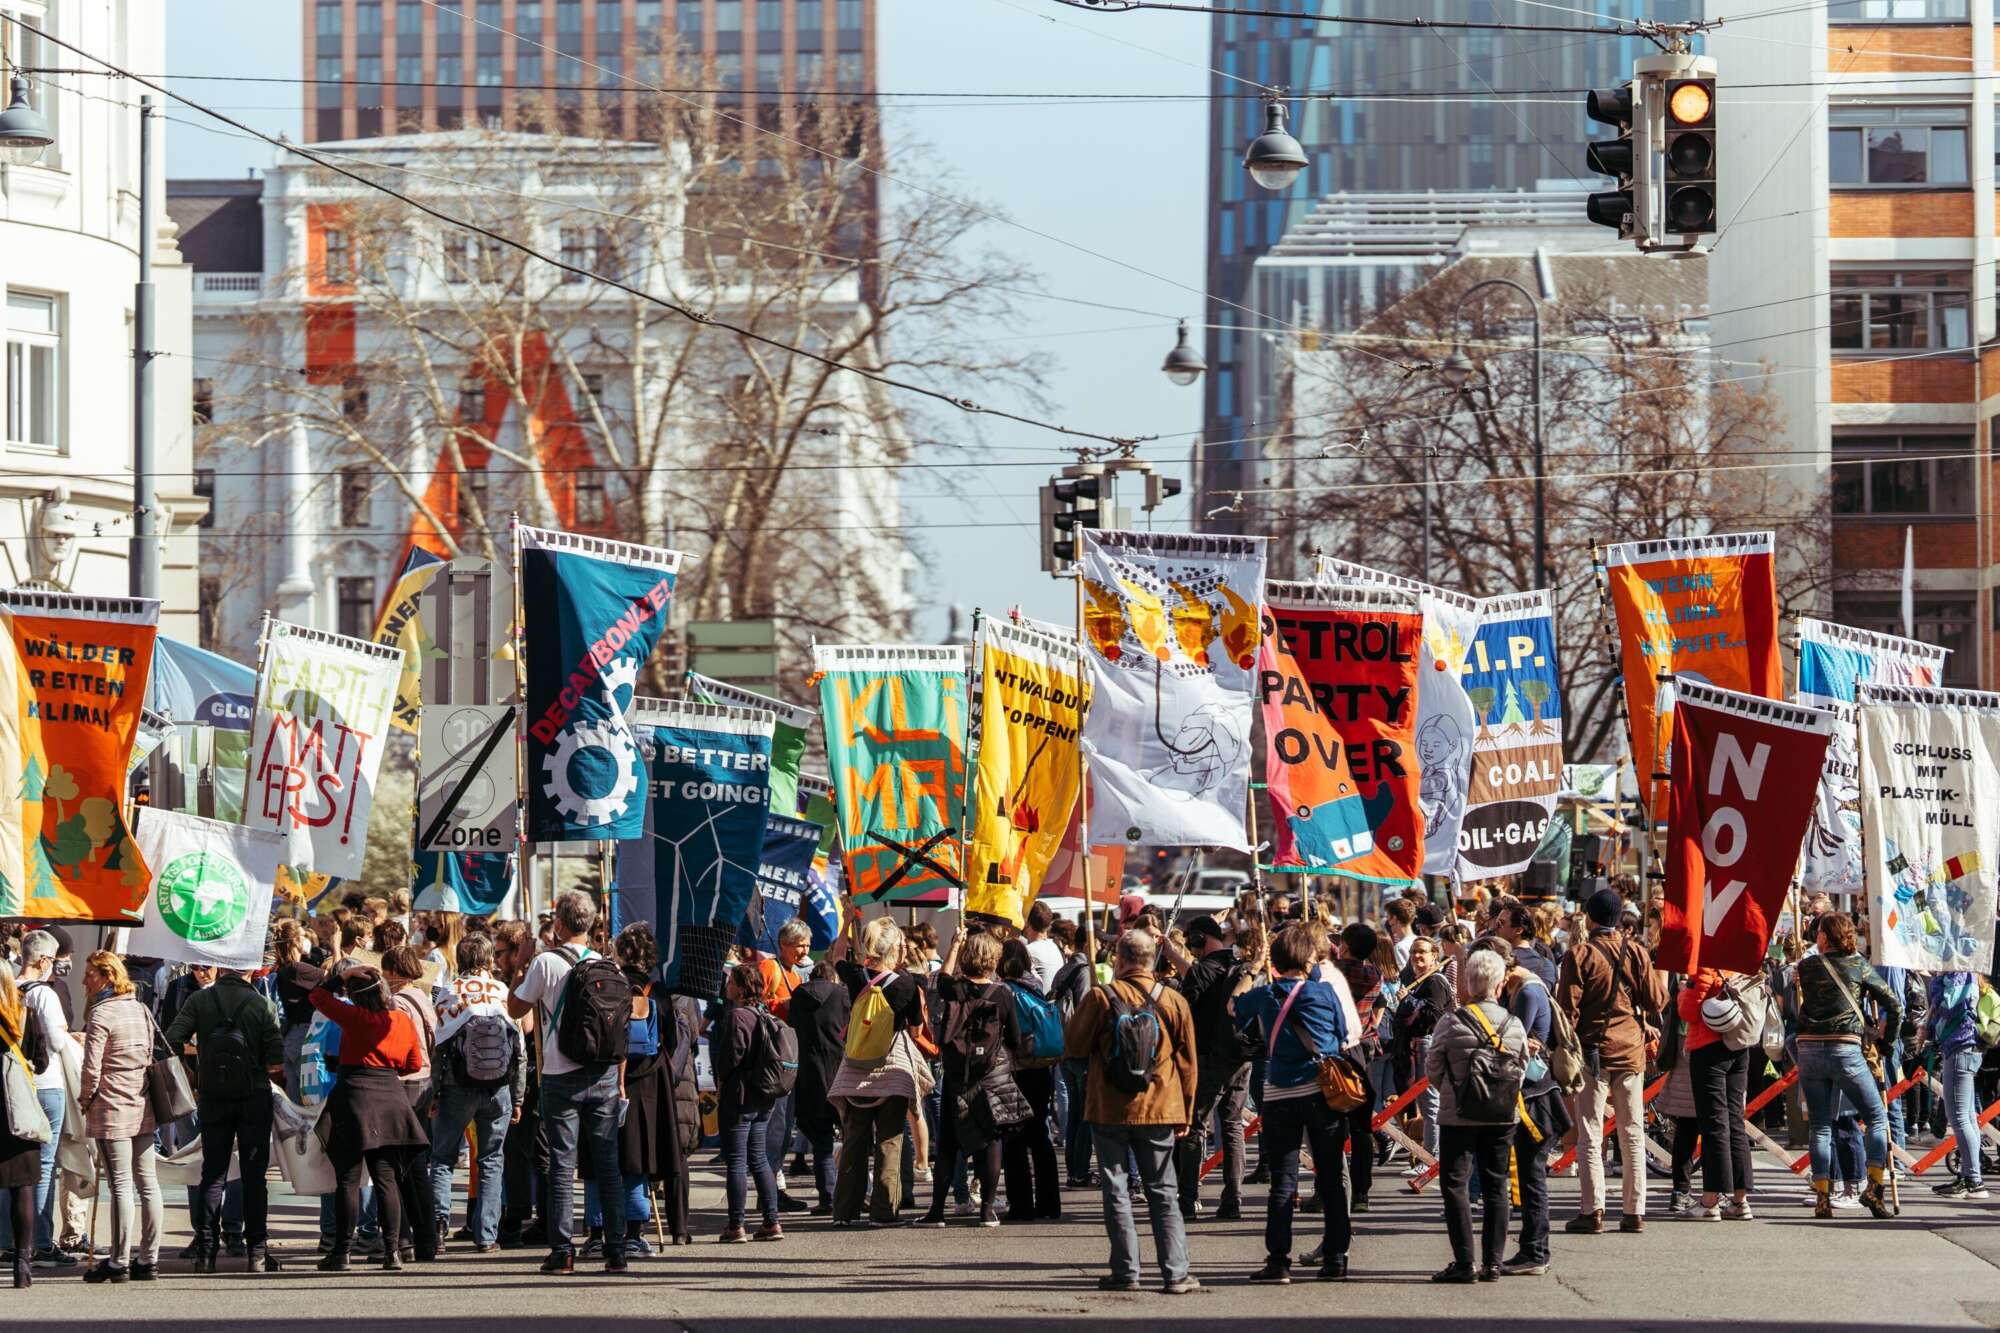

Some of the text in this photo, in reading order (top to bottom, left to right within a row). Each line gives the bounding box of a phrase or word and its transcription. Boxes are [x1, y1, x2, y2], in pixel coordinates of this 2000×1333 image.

[1646, 573, 1713, 595] WENN
[1645, 603, 1721, 624] KLIMA
[24, 633, 135, 666] WÄLDER
[1261, 615, 1412, 663] PETROL
[1462, 635, 1546, 675] .I.P.
[30, 669, 125, 698] RETTEN
[267, 656, 389, 736] EARTH
[1261, 670, 1411, 722] PARTY
[28, 700, 111, 733] KLIMA!
[211, 701, 253, 719] GLO
[1274, 728, 1408, 783] OVER
[1893, 742, 1973, 761] SCHLUSS
[1488, 759, 1556, 788] COAL
[1917, 765, 1948, 778] MIT
[682, 781, 769, 807] GOING!
[1880, 786, 1960, 801] PLASTIK-
[1925, 808, 1974, 828] MÜLL
[434, 820, 502, 847] Zone
[1458, 817, 1549, 852] OIL+GAS
[159, 864, 181, 914] ARTISTS
